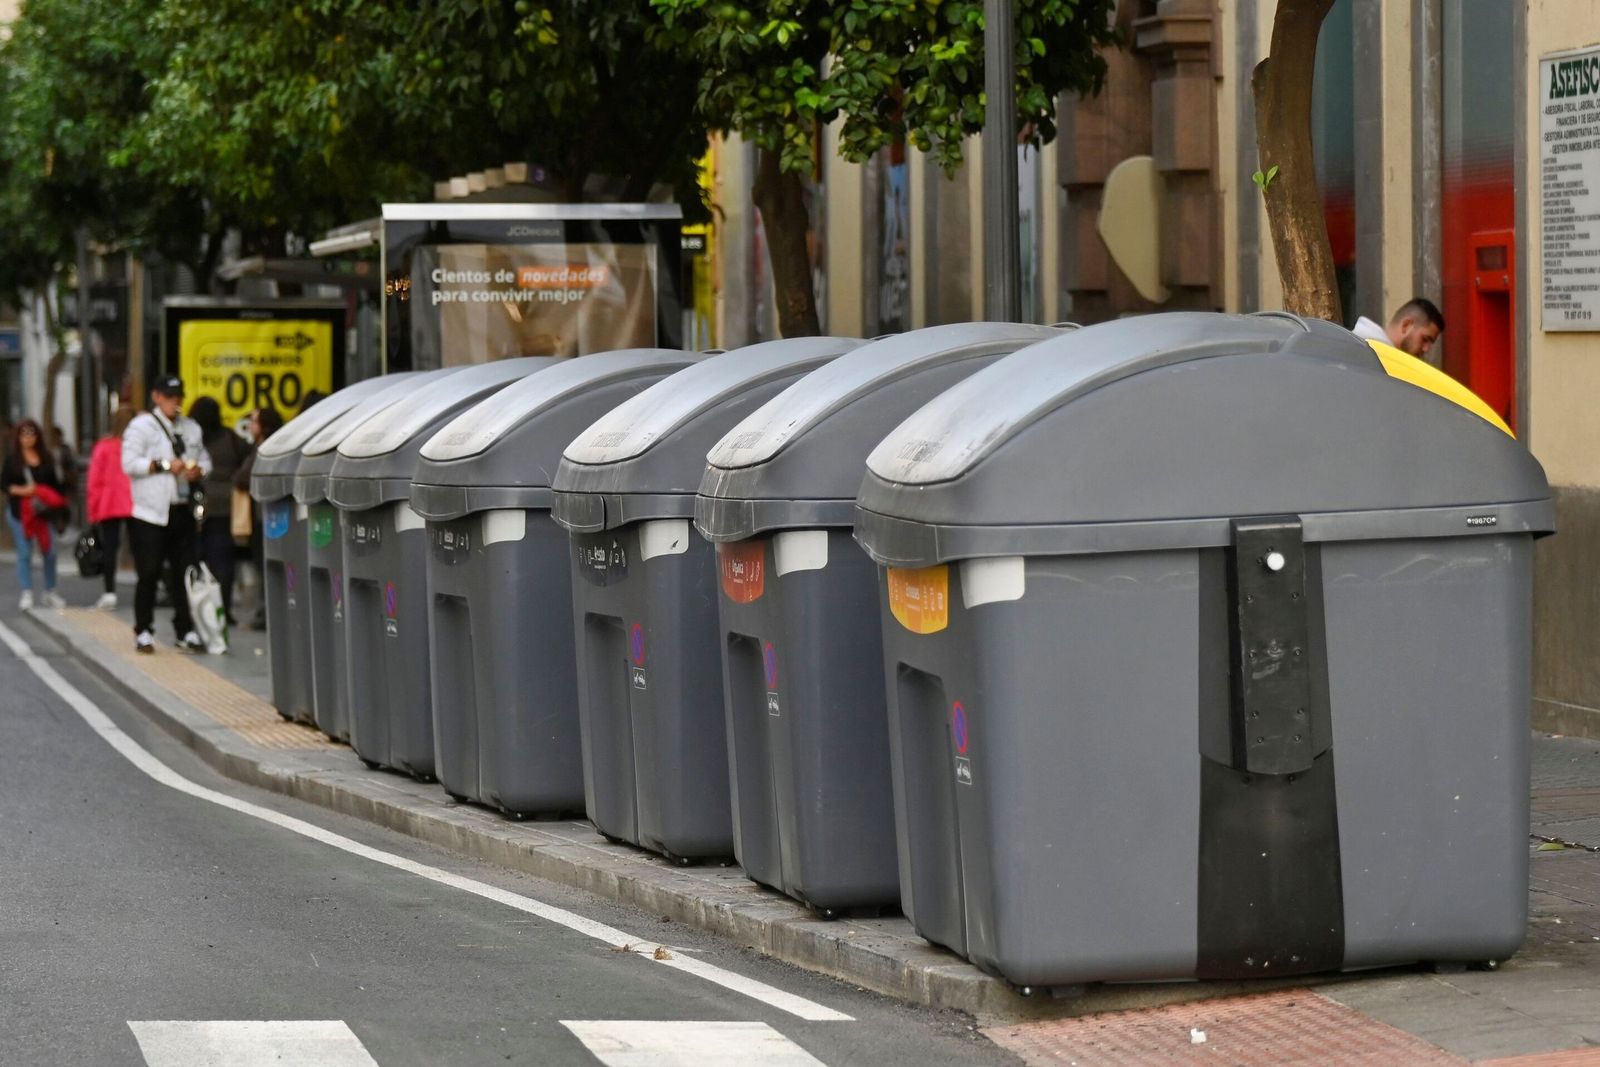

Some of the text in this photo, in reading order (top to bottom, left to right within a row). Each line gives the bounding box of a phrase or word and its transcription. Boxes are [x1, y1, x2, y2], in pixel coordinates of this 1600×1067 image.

[1549, 57, 1600, 99] ASEFISC
[432, 268, 603, 283] Cientos de novedades
[432, 287, 584, 305] para convivir mejor
[226, 371, 302, 409] ORO
